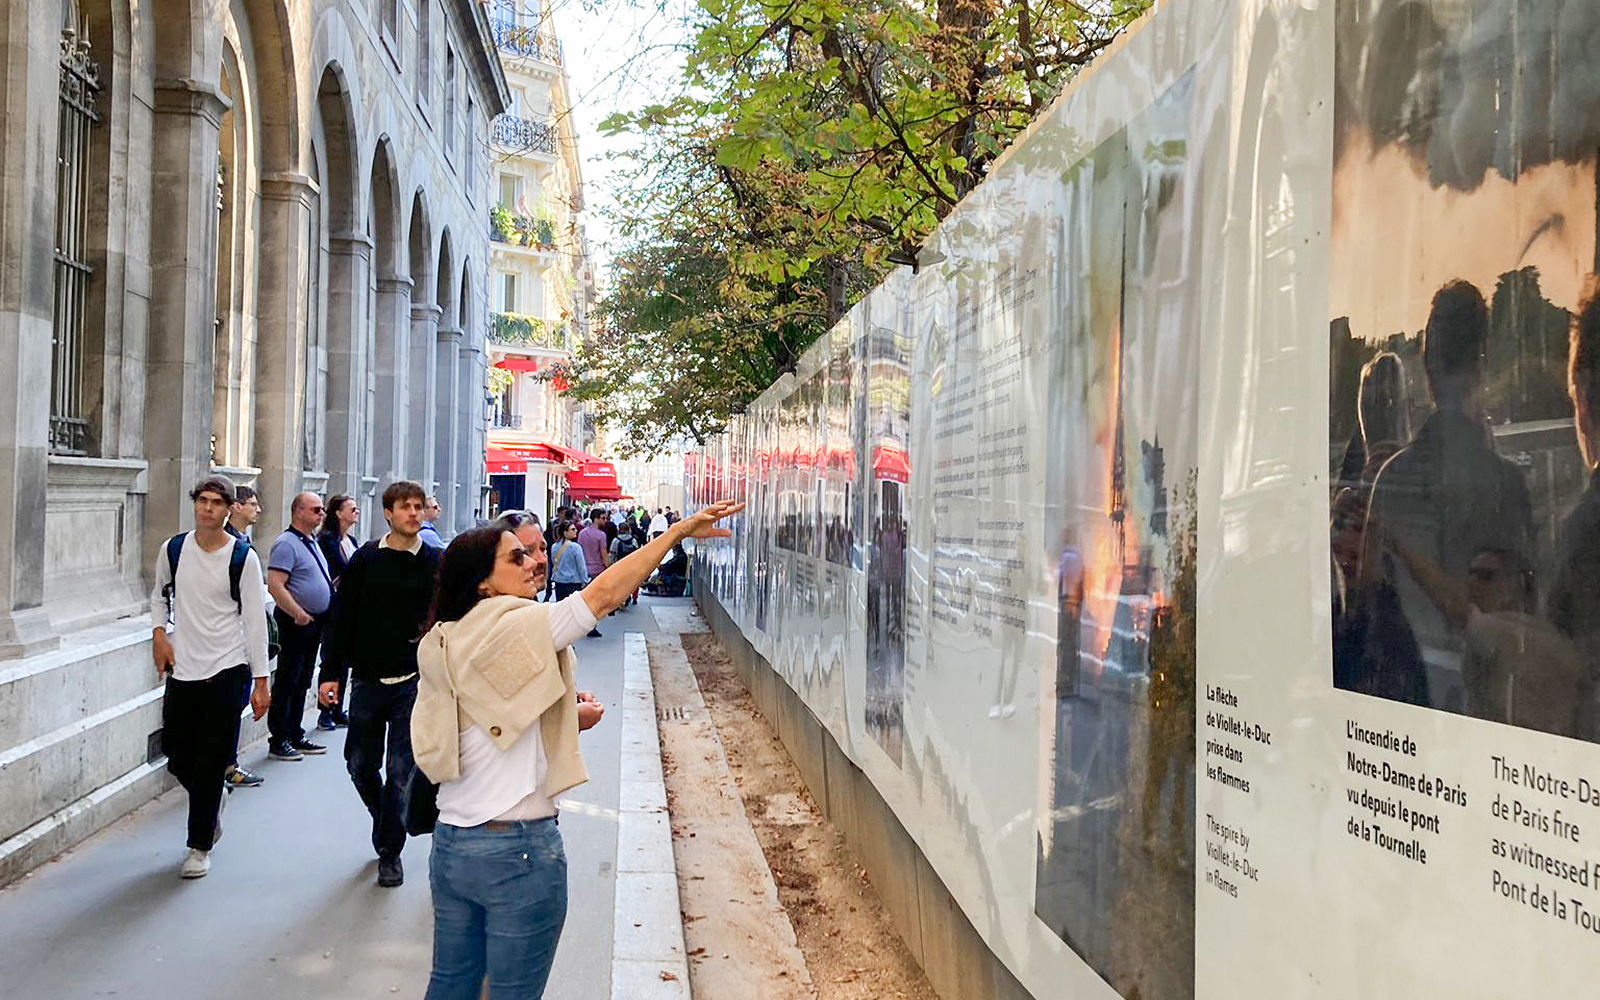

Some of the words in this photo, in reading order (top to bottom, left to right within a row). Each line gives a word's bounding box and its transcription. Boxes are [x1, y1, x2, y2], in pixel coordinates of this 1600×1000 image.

[1207, 684, 1215, 701] La
[1216, 686, 1238, 707] flèche
[1206, 711, 1215, 727] de
[1216, 712, 1271, 745] Viollet-le-Duc
[1347, 719, 1400, 752] L'incendie
[1402, 735, 1417, 757] de
[1206, 738, 1224, 756] prise
[1225, 743, 1242, 763] dans
[1491, 755, 1519, 785] The
[1206, 762, 1216, 780] les
[1217, 766, 1250, 793] flammes
[1347, 751, 1415, 791] Notre-Dame
[1418, 773, 1432, 796] de
[1436, 777, 1467, 807] Paris
[1347, 788, 1359, 805] vu
[1361, 789, 1396, 818] depuis
[1398, 800, 1409, 823] le
[1411, 810, 1440, 834] pont
[1492, 793, 1509, 821] de
[1513, 800, 1549, 833] Paris
[1554, 810, 1580, 843] fire
[1206, 813, 1220, 835] The
[1221, 824, 1238, 844] spire
[1240, 828, 1250, 853] by
[1347, 816, 1359, 837] de
[1361, 820, 1371, 841] la
[1373, 824, 1426, 864] Tournelle
[1206, 840, 1259, 882] Viollet-le-Duc
[1492, 837, 1507, 858] as
[1509, 843, 1589, 887] witnessed
[1206, 867, 1214, 883] in
[1214, 869, 1238, 898] flames
[1492, 869, 1526, 904] Pont
[1530, 883, 1548, 913] de
[1553, 890, 1566, 920] la
